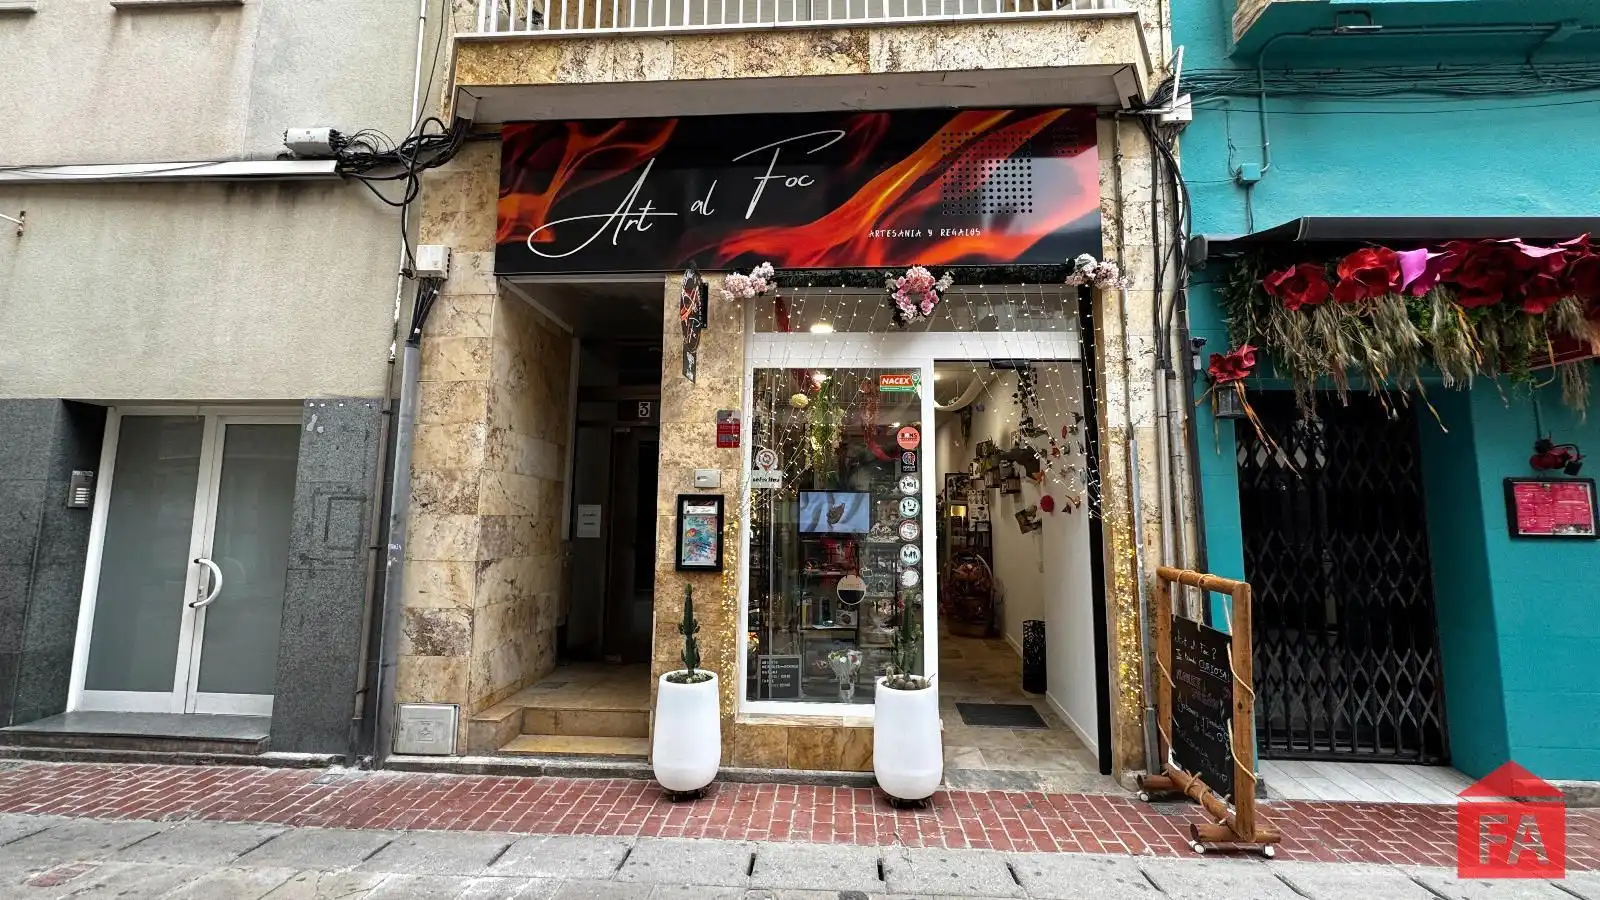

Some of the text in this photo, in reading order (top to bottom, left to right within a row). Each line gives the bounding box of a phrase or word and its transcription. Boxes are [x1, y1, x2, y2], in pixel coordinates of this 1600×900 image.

[527, 129, 846, 258] Art al Foc
[868, 228, 922, 238] ARTESANIA
[940, 227, 982, 237] REGALOS
[881, 377, 910, 385] NACEX
